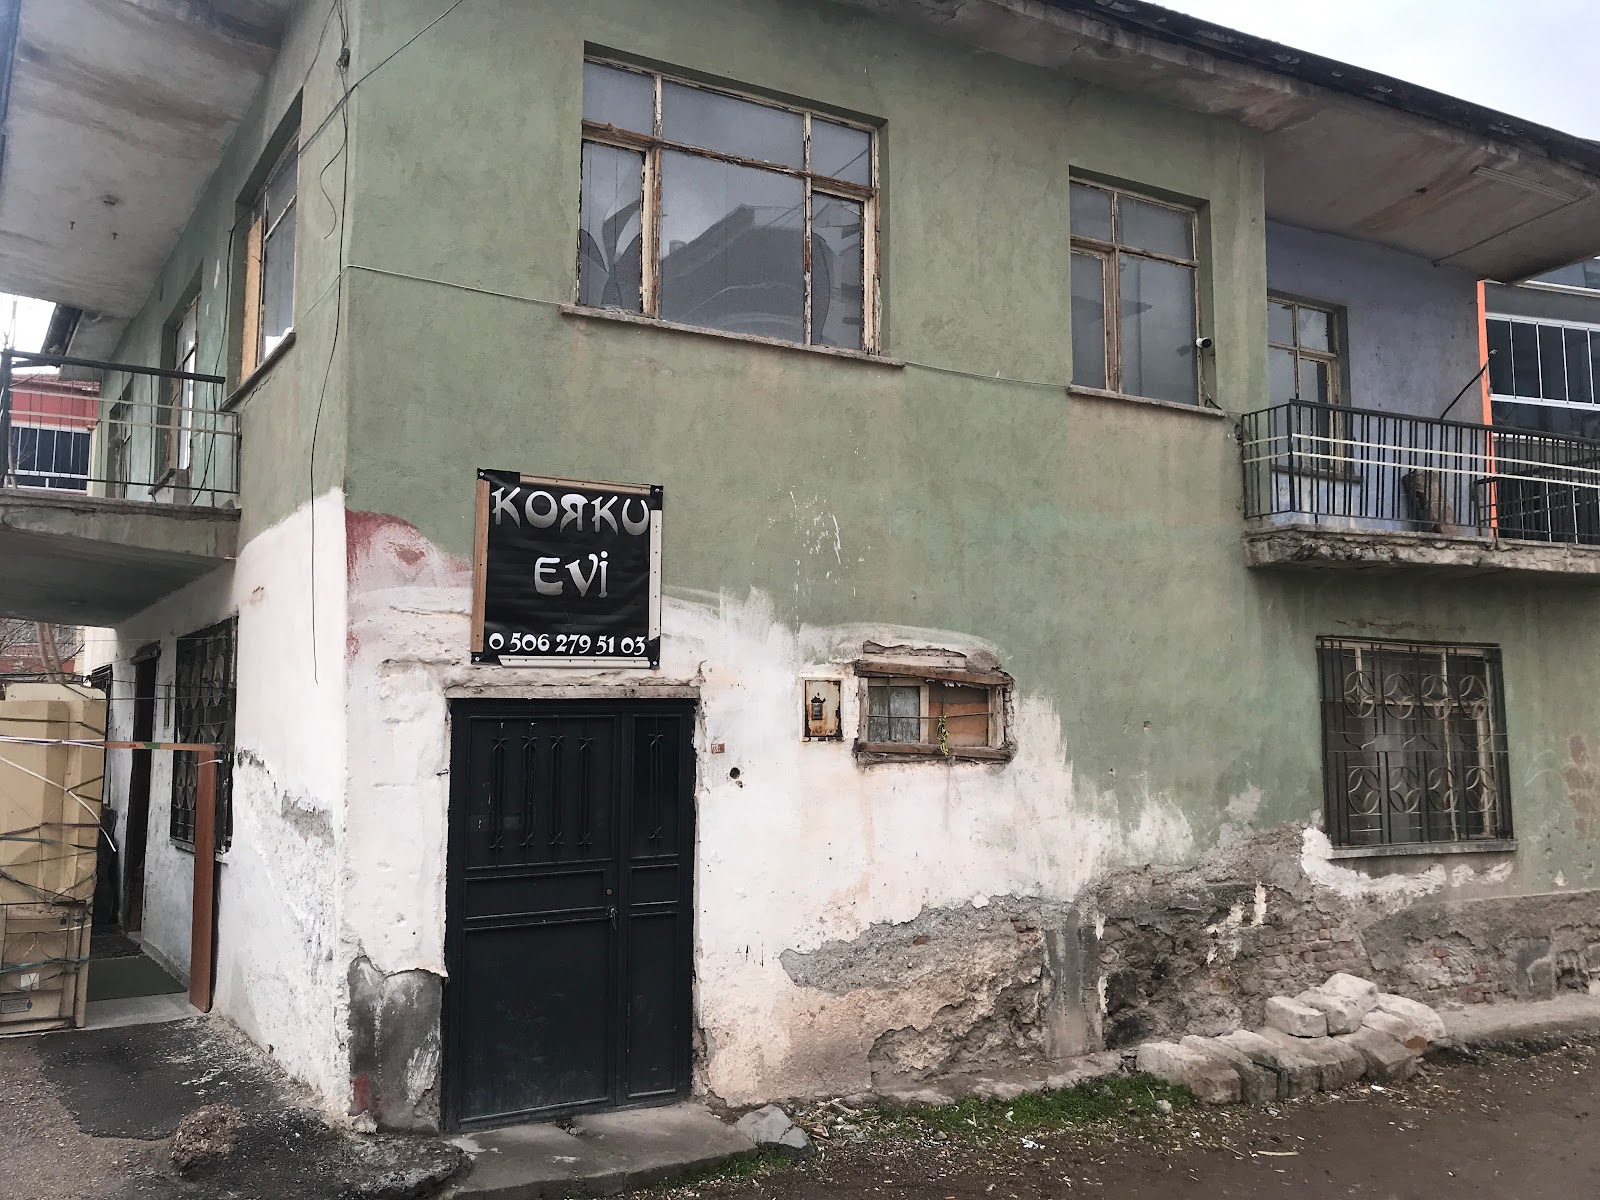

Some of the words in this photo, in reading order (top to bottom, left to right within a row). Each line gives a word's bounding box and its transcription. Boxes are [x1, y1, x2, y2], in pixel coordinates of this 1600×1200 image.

[488, 632, 505, 650] 0
[509, 632, 550, 652] 506
[555, 633, 592, 654] 279
[596, 635, 615, 654] 51
[620, 636, 646, 655] 03
